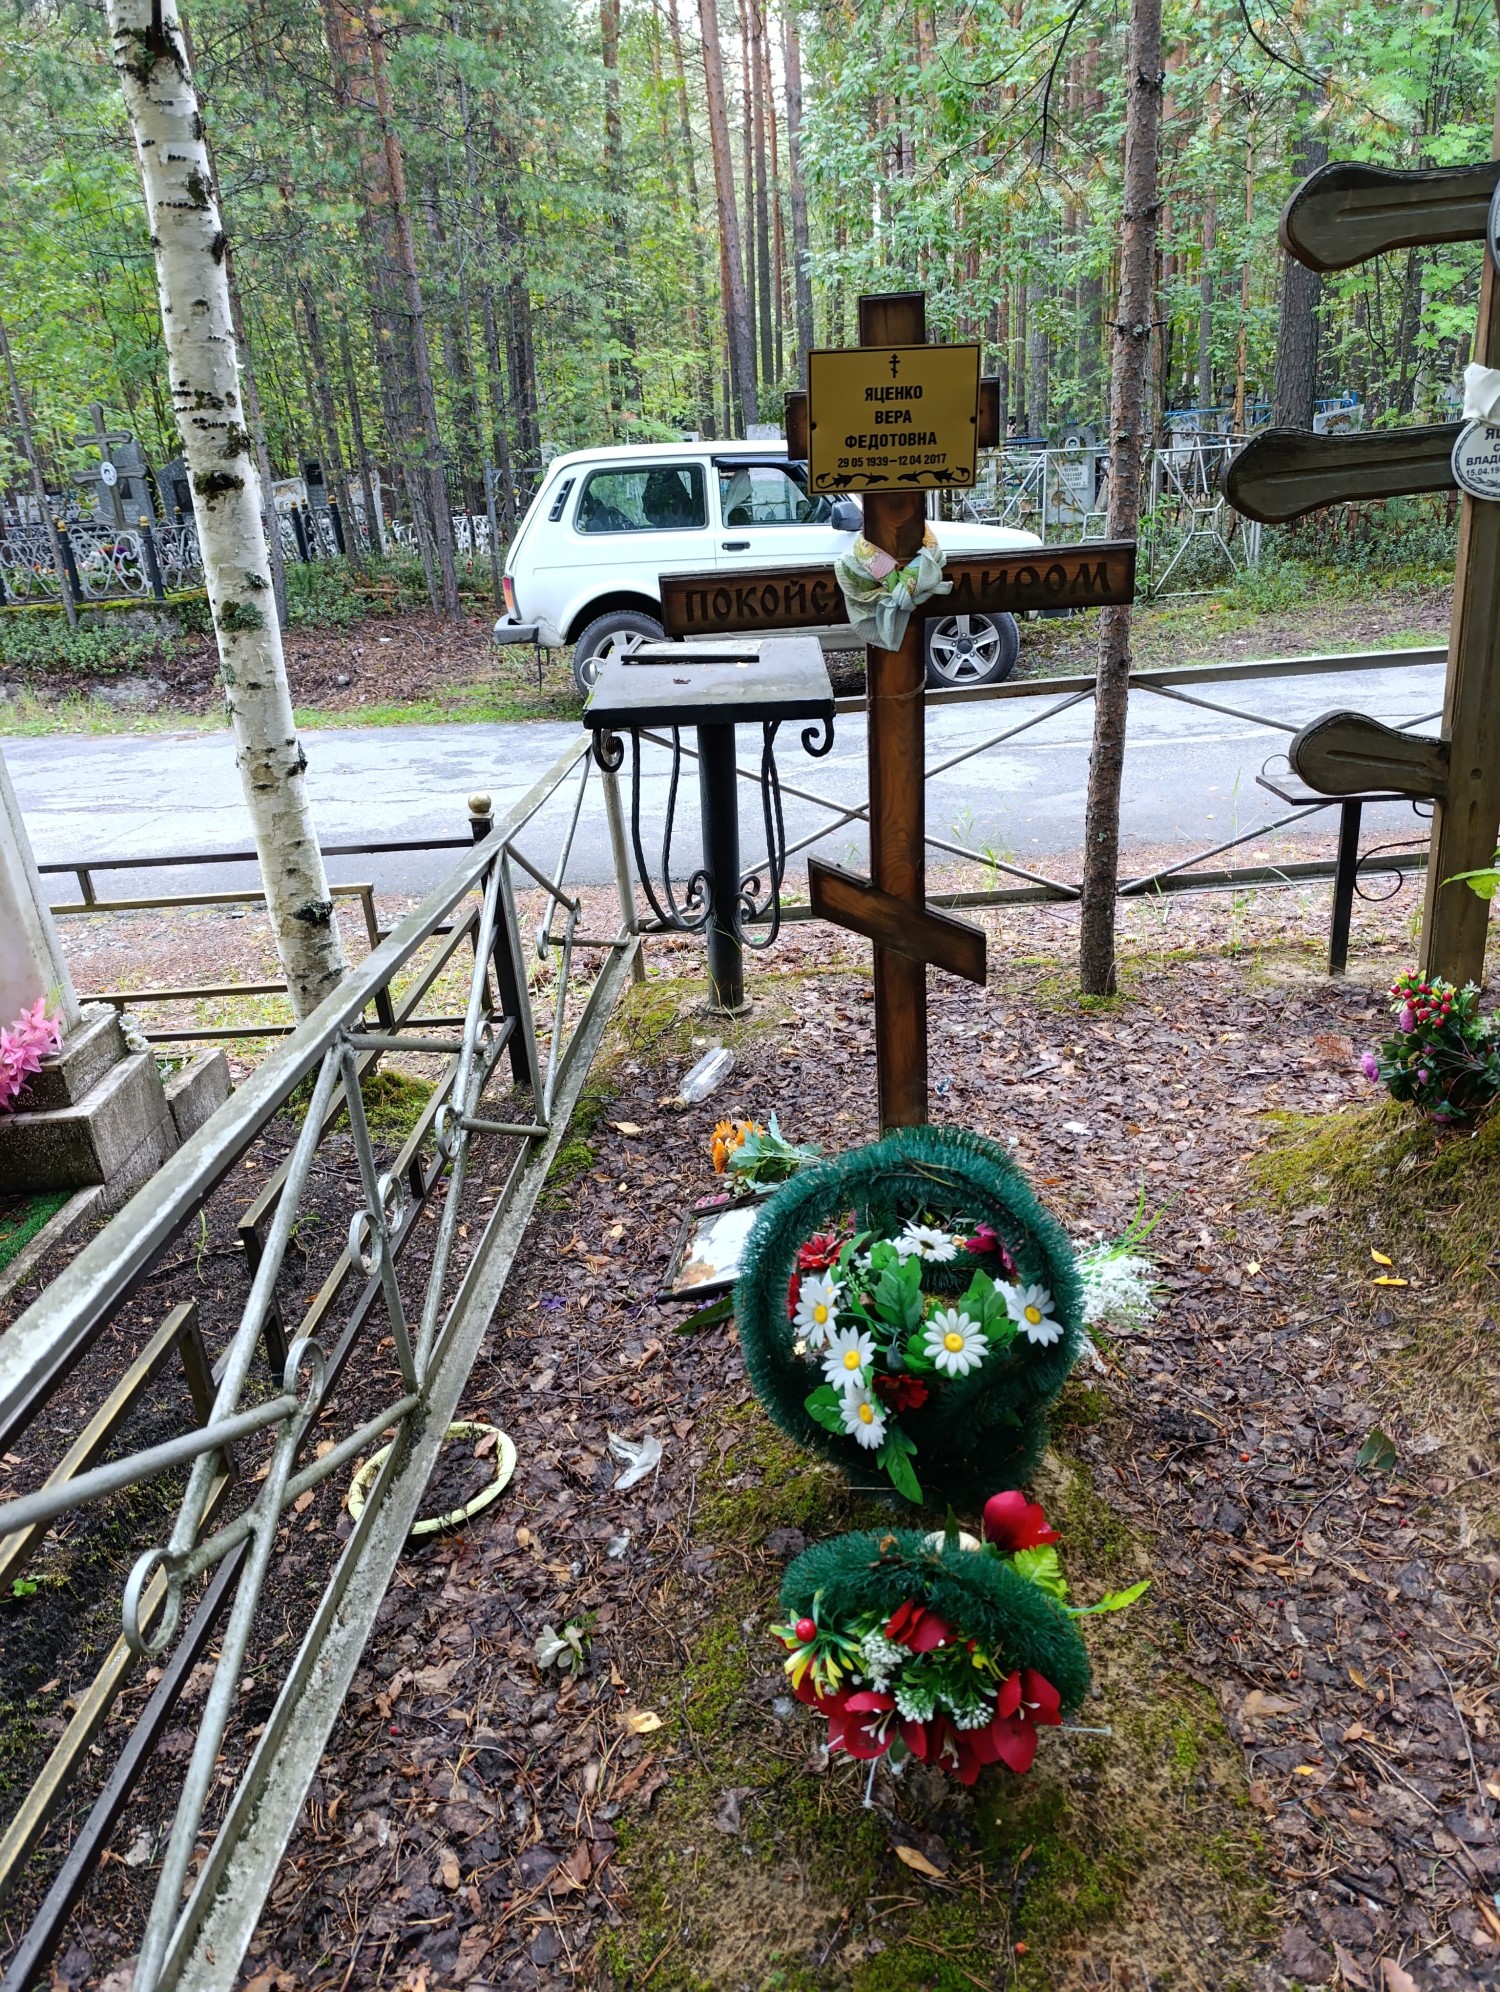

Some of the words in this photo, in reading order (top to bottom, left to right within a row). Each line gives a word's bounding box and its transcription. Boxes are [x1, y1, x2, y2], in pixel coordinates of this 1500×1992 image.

[864, 385, 923, 403] ЯЦЕНКО
[874, 409, 912, 424] ВЕРА
[844, 431, 937, 450] ФЕДОТОВНА
[837, 457, 849, 468] 29
[851, 457, 863, 467] 05
[909, 453, 921, 465] 04
[924, 453, 946, 464] 2017
[1466, 455, 1500, 466] ВЛАД
